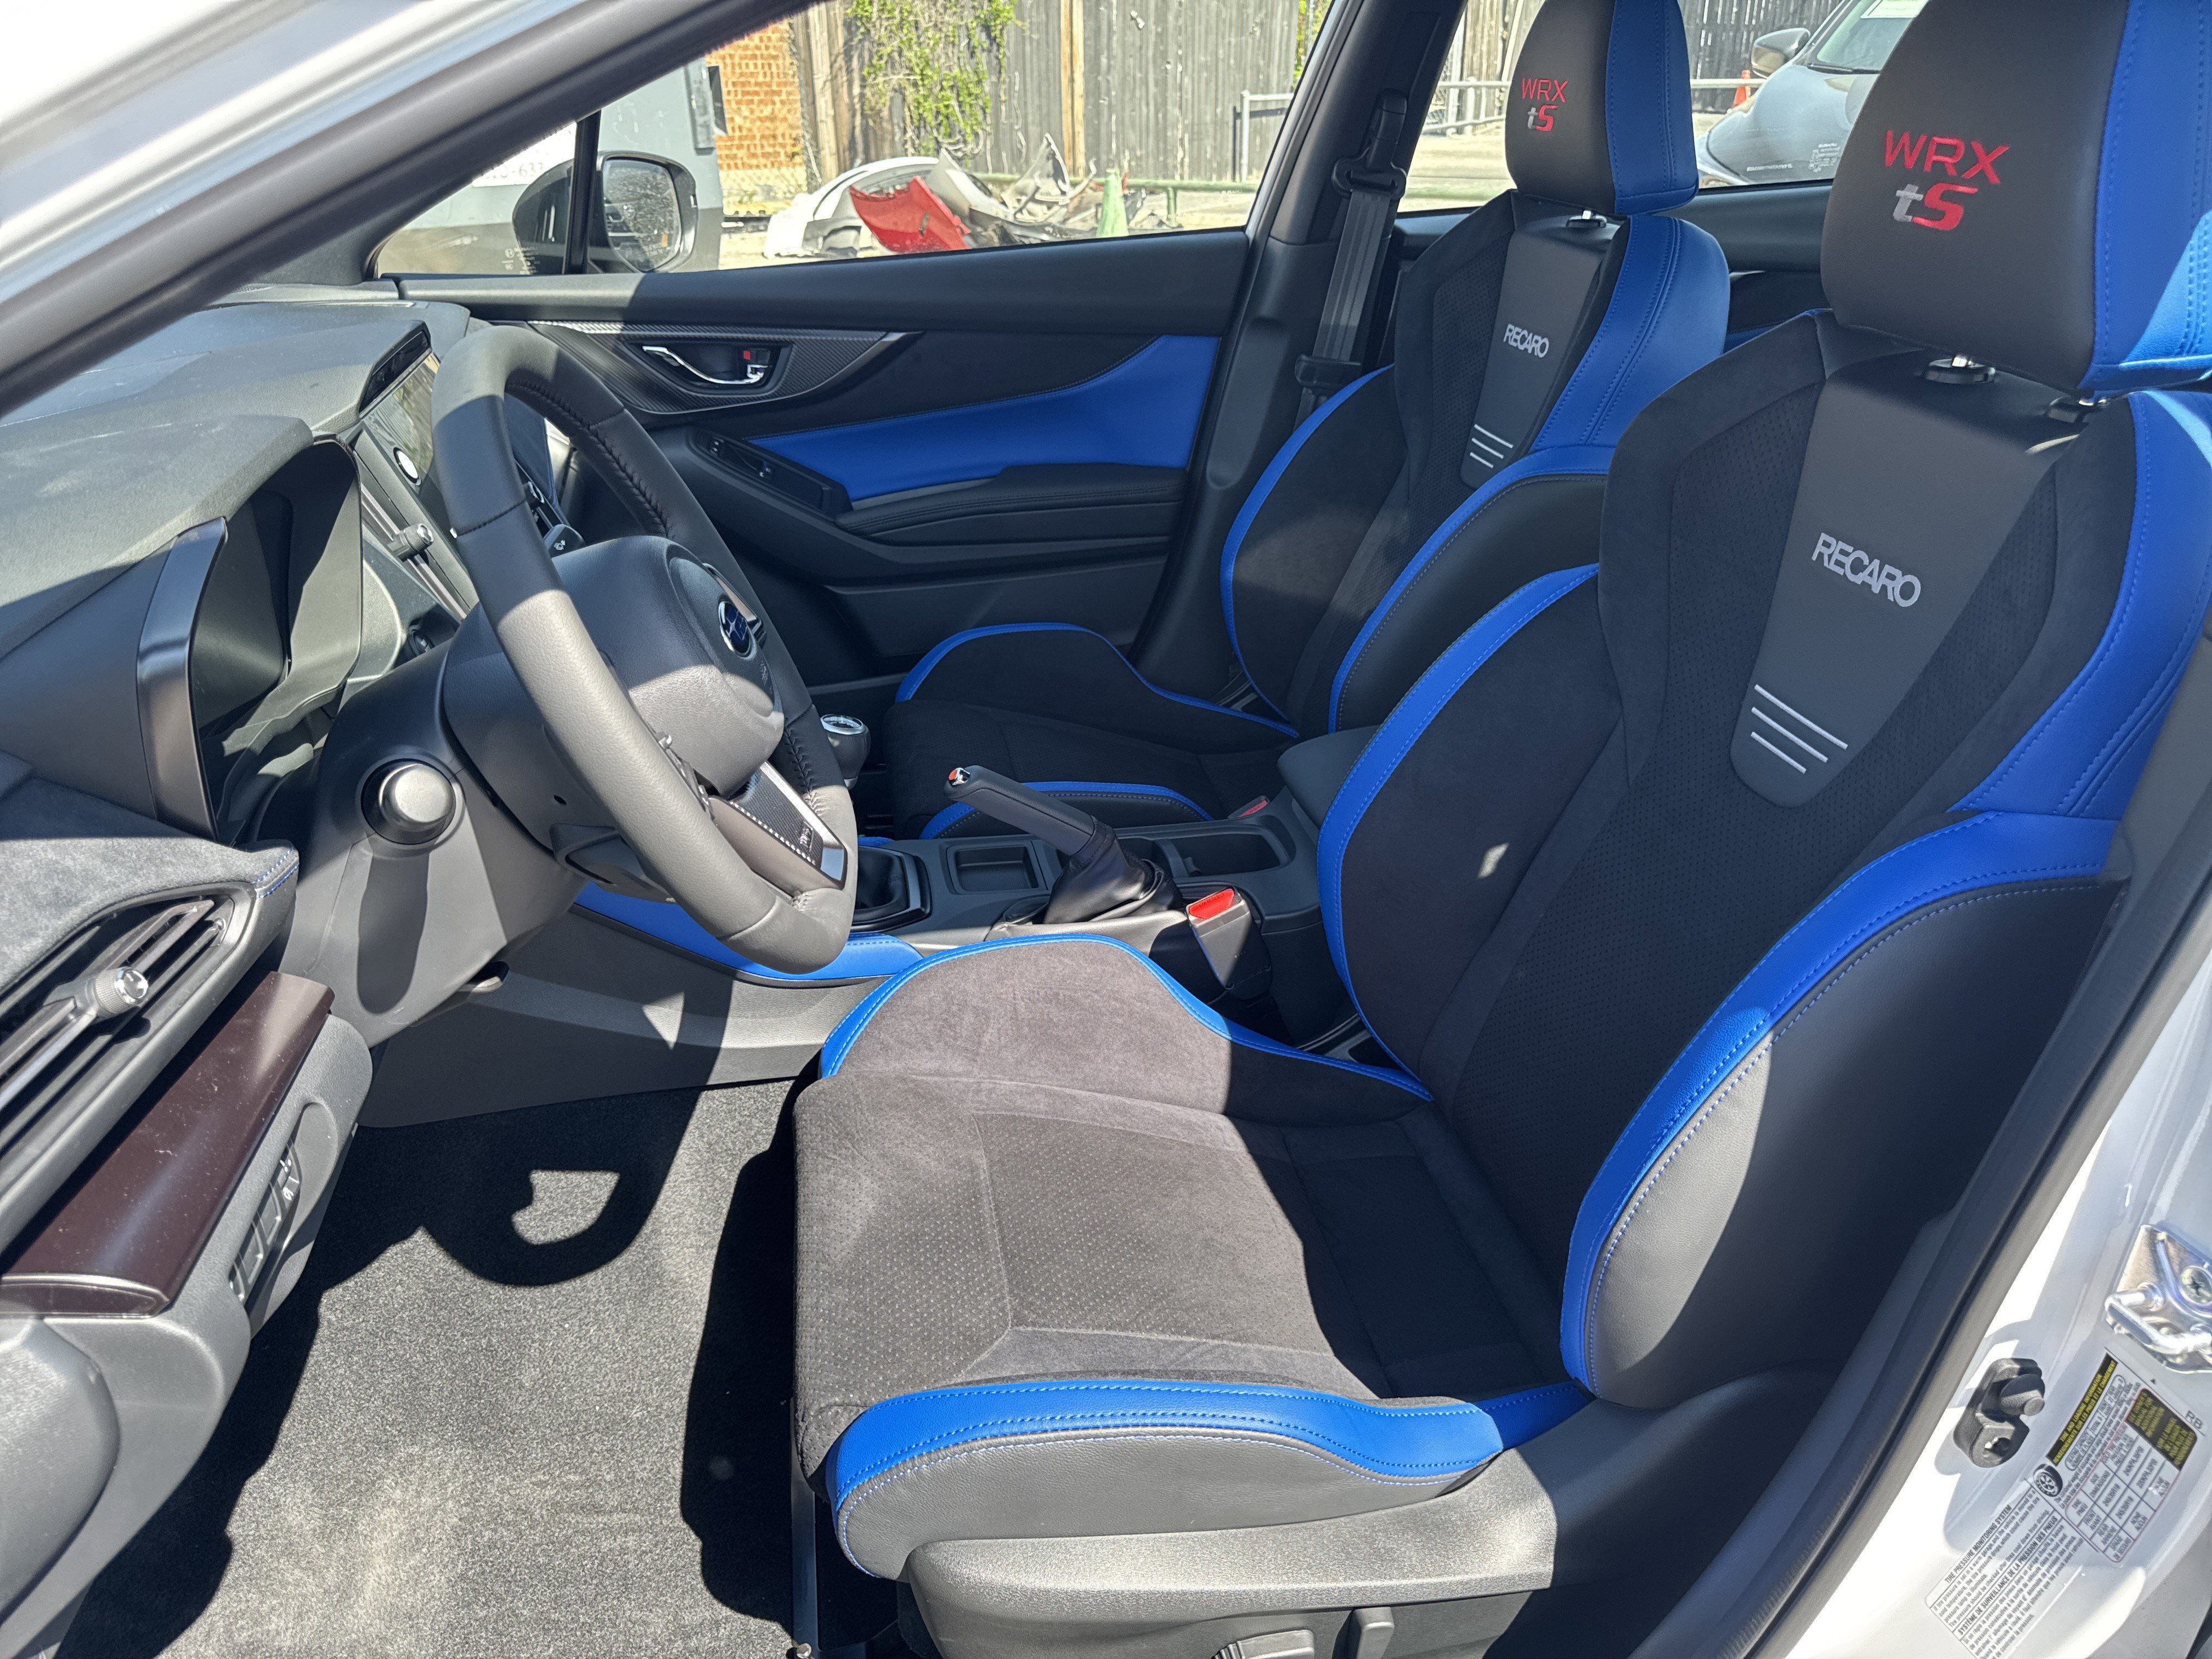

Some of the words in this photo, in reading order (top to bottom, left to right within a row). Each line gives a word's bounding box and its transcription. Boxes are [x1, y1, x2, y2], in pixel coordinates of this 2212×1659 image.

[1521, 77, 1568, 103] WRX
[1527, 104, 1559, 132] tS
[1884, 130, 2010, 184] WRX
[1893, 182, 1978, 230] tS
[1503, 324, 1549, 358] RECARO
[1812, 532, 1921, 607] RECARO
[2066, 1420, 2075, 1432] AND
[2185, 1410, 2202, 1429] RB
[1944, 1571, 1955, 1584] TIRE
[1953, 1549, 1975, 1574] PRESSURE
[1972, 1522, 1997, 1551] MONITORING
[1994, 1504, 2012, 1525] SYSTEM
[1974, 1606, 1983, 1615] DE
[1980, 1575, 2010, 1609] SURVEILLANCE
[2007, 1568, 2015, 1577] DE
[2012, 1562, 2020, 1571] LA
[2017, 1540, 2038, 1564] PRESSION
[2035, 1531, 2046, 1542] DES
[2042, 1515, 2058, 1533] PNEUS
